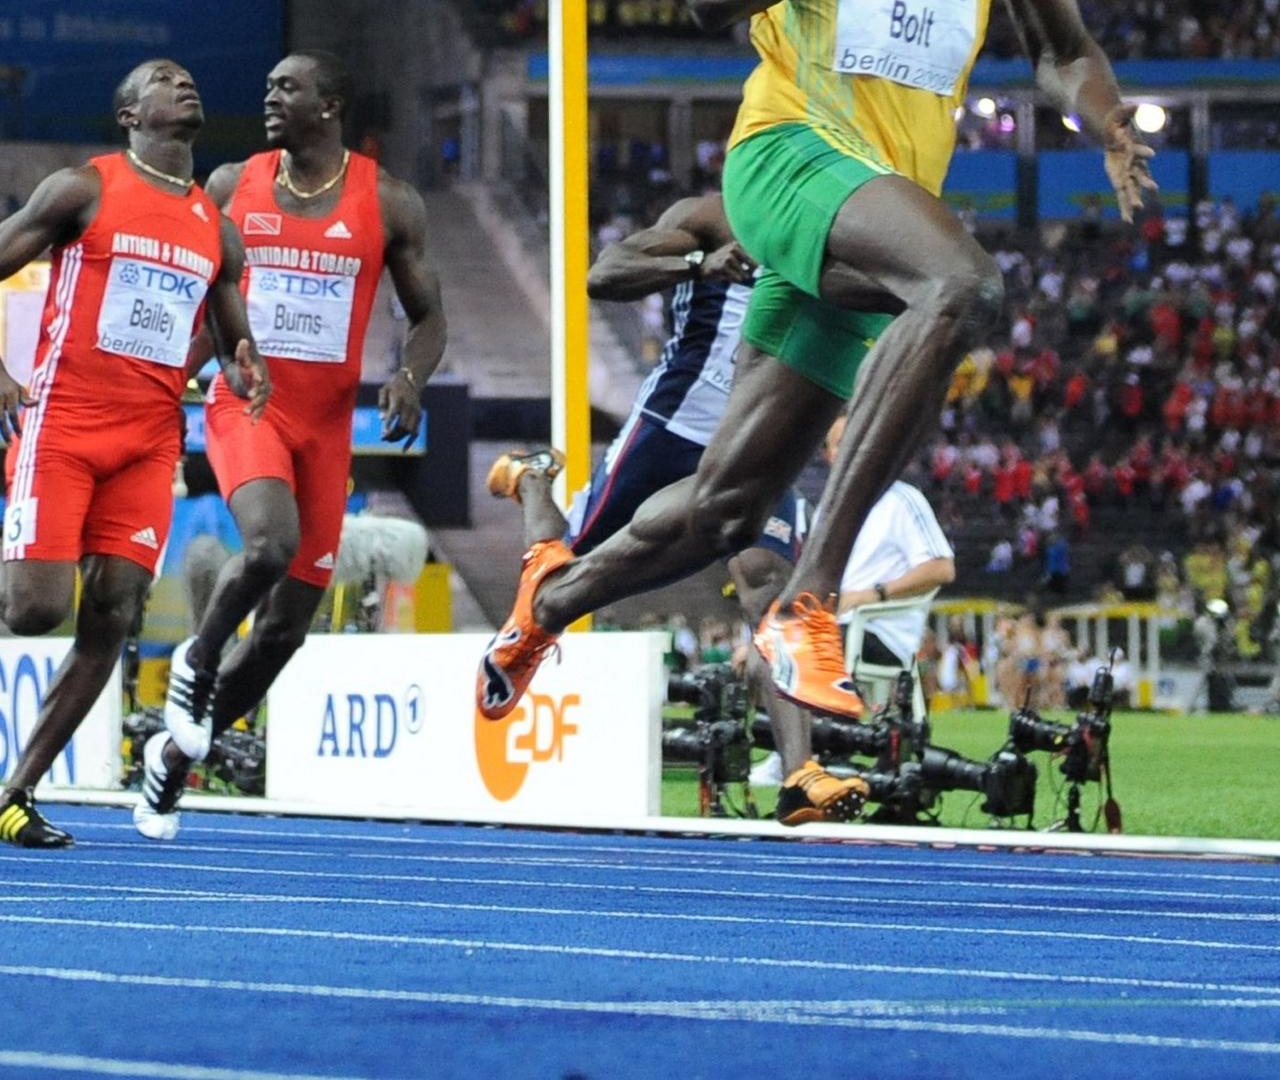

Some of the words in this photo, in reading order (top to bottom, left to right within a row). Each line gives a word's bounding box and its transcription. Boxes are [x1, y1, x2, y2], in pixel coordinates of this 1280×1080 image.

[889, 0, 935, 48] Bolt
[840, 48, 910, 81] berlin
[244, 246, 300, 268] RINIDAD
[300, 249, 311, 271] &
[311, 251, 362, 277] TOBAGO
[141, 265, 198, 300] TDK
[280, 273, 342, 298] TDK
[129, 298, 177, 341] Bailey
[274, 304, 323, 335] Burns
[100, 331, 154, 358] berlin
[8, 506, 22, 542] 3
[317, 693, 398, 758] ARD
